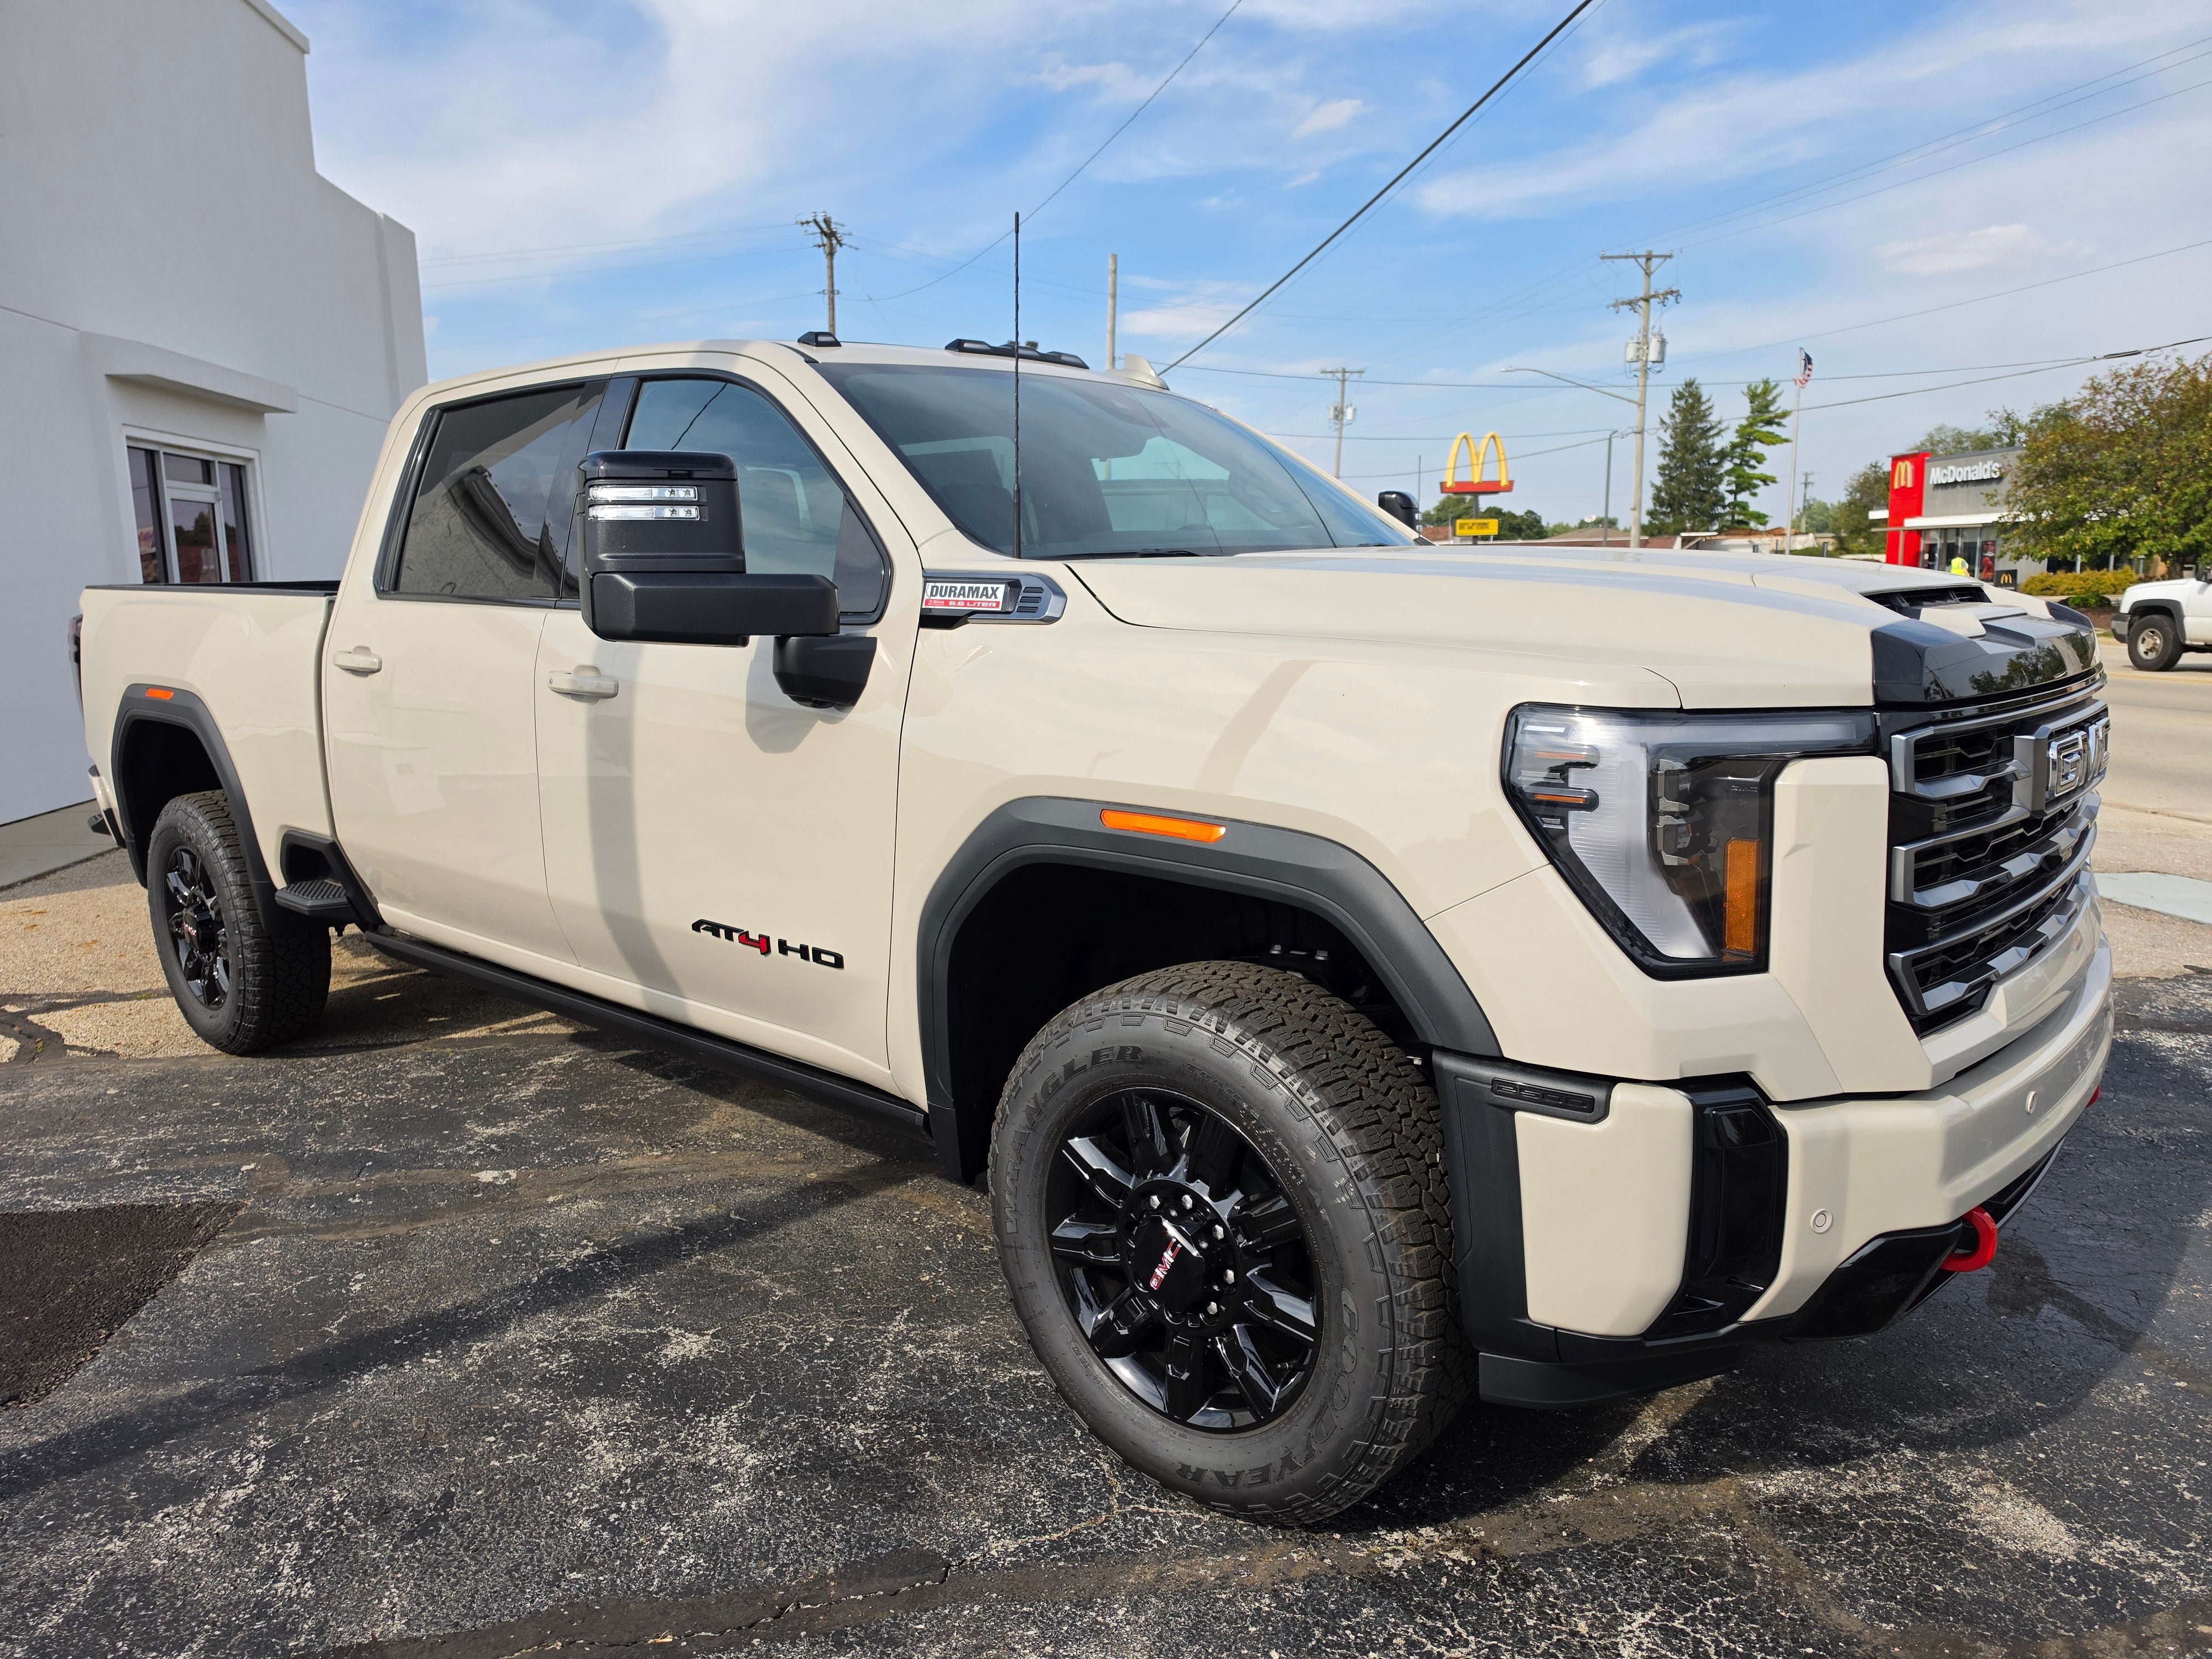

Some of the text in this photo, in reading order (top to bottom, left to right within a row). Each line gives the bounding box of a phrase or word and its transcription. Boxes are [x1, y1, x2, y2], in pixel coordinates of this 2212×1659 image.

[1929, 460, 2002, 485] McDonald's
[930, 585, 1000, 599] DURAMAX
[691, 919, 844, 969] AT4 HD
[1003, 1045, 1144, 1235] WRANGLER
[1150, 1237, 1182, 1291] GMC
[1175, 1287, 1359, 1489] GOODYEAR
